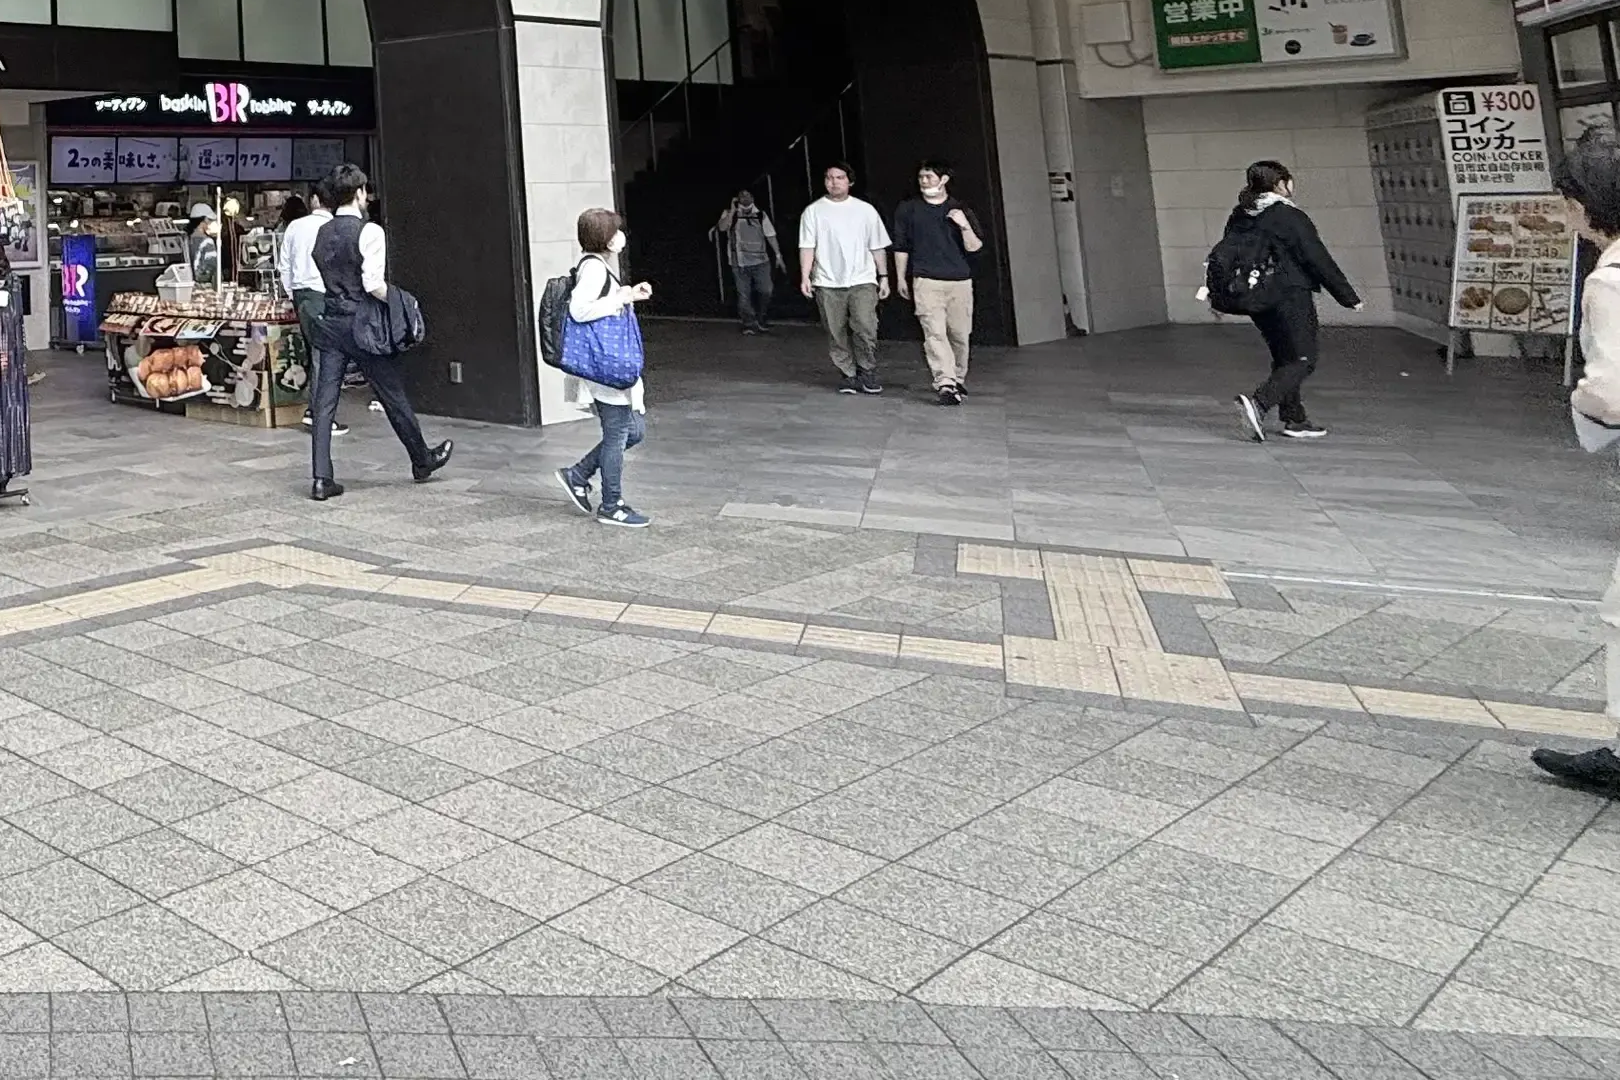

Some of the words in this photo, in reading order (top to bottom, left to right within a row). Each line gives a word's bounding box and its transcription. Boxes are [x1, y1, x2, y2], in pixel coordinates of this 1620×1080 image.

[205, 82, 250, 122] BR
[1481, 90, 1536, 112] ¥300
[1446, 116, 1516, 134] コイン
[1450, 133, 1542, 151] ロッカー
[1452, 150, 1543, 162] COIN-LOCKER
